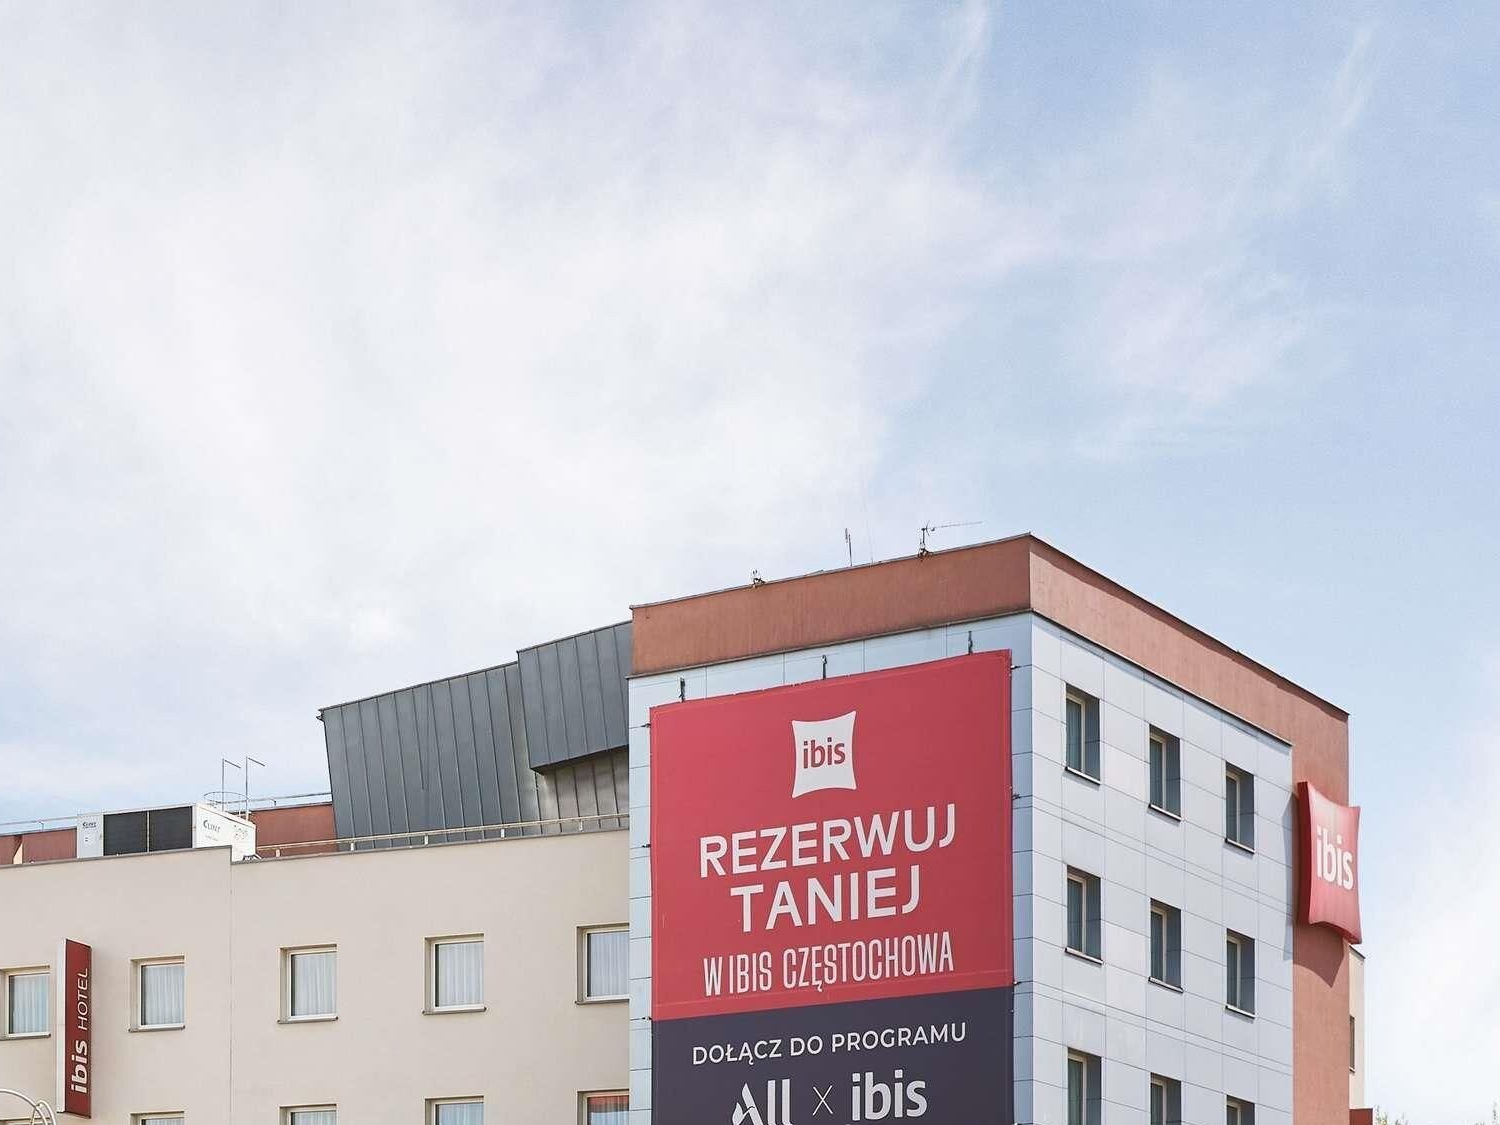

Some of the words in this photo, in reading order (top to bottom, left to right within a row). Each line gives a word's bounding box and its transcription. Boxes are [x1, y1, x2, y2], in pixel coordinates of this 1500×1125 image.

[802, 736, 847, 770] ibis
[699, 803, 956, 878] REZERWUJ
[1316, 823, 1354, 890] ibis
[730, 864, 921, 933] TANIEJ
[703, 956, 724, 997] W
[728, 950, 773, 995] IBIS
[782, 931, 955, 993] CZĘSTOCHOWA
[77, 967, 89, 1032] HOTEL
[71, 1039, 88, 1094] ibis
[692, 1038, 783, 1066] DOŁĄCZ
[789, 1034, 824, 1057] DO
[831, 1021, 967, 1053] PROGRAMU
[851, 1068, 929, 1122] ibis
